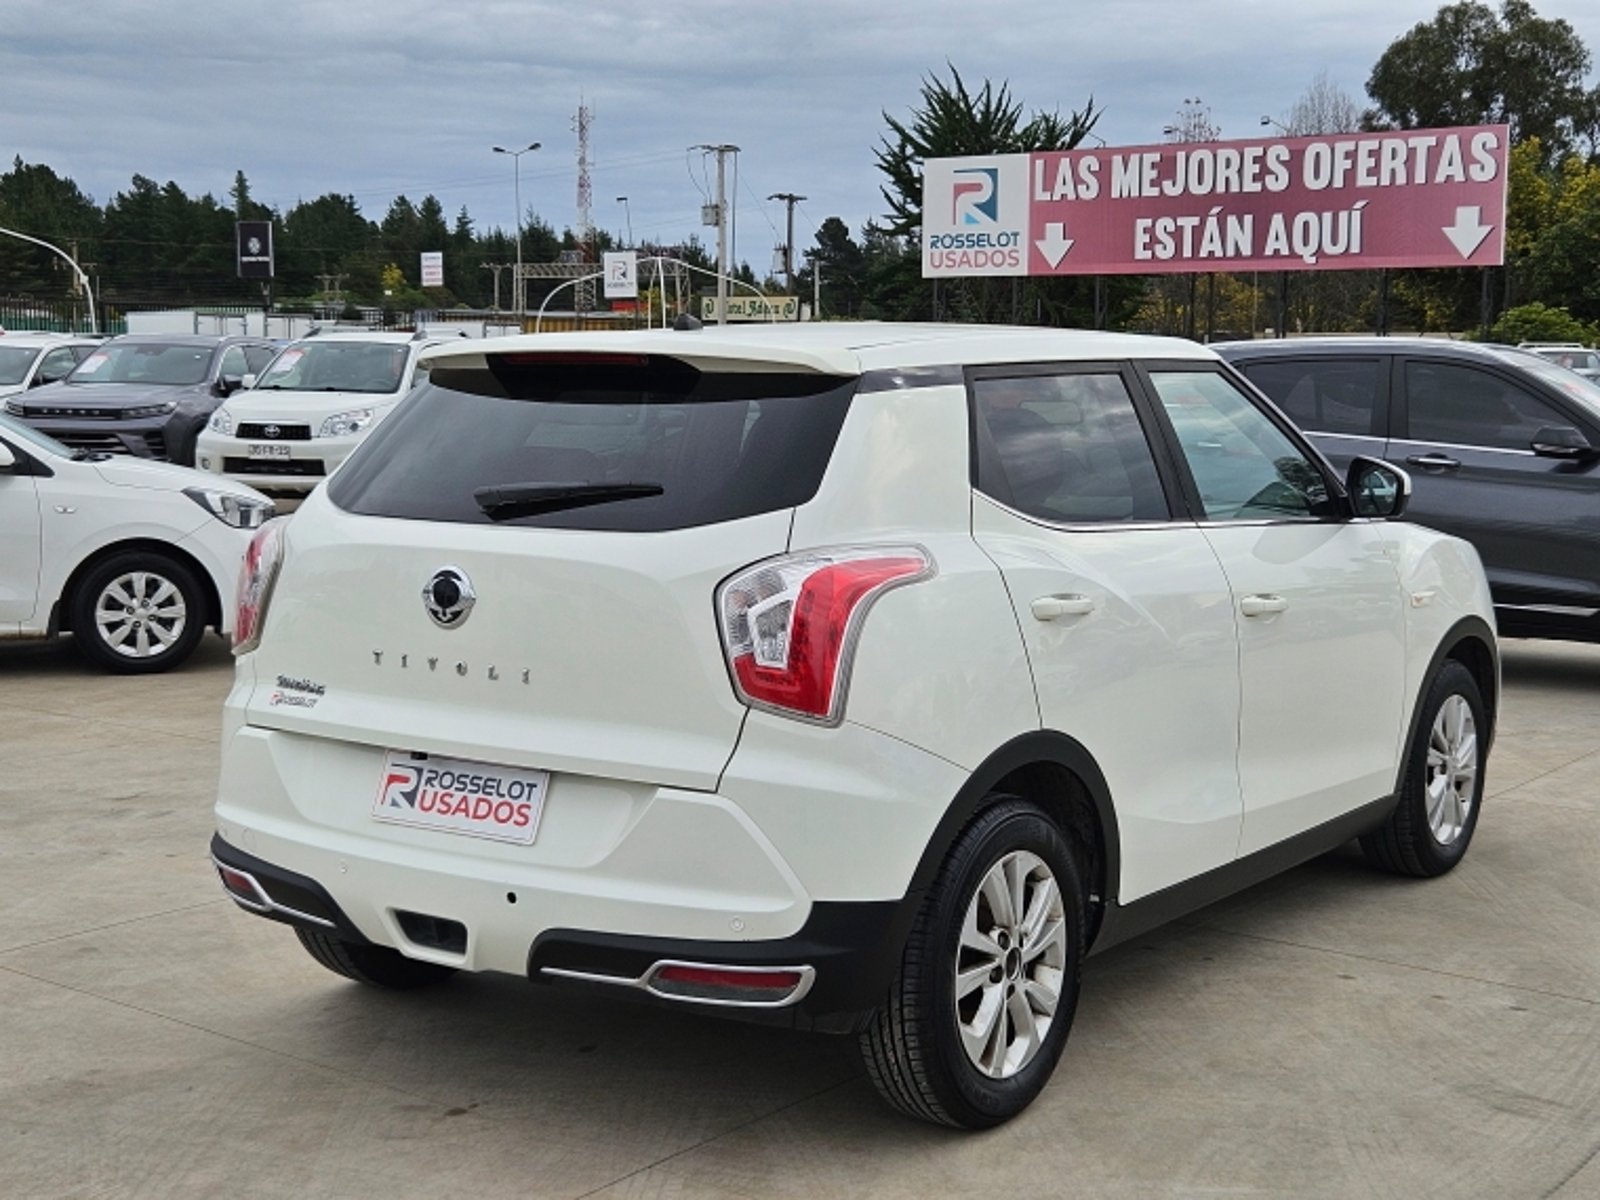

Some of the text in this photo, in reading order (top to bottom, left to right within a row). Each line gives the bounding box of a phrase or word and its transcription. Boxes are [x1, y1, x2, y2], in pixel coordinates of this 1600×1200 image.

[1034, 132, 1498, 201] LAS MEJORES OFERTAS
[930, 232, 1020, 249] ROSSELOT
[1134, 200, 1370, 264] ESTÁN AQUÍ
[930, 249, 1020, 269] USADOS
[373, 650, 530, 685] TIVOLI
[424, 769, 538, 801] ROSSELOT
[419, 788, 533, 828] USADOS
